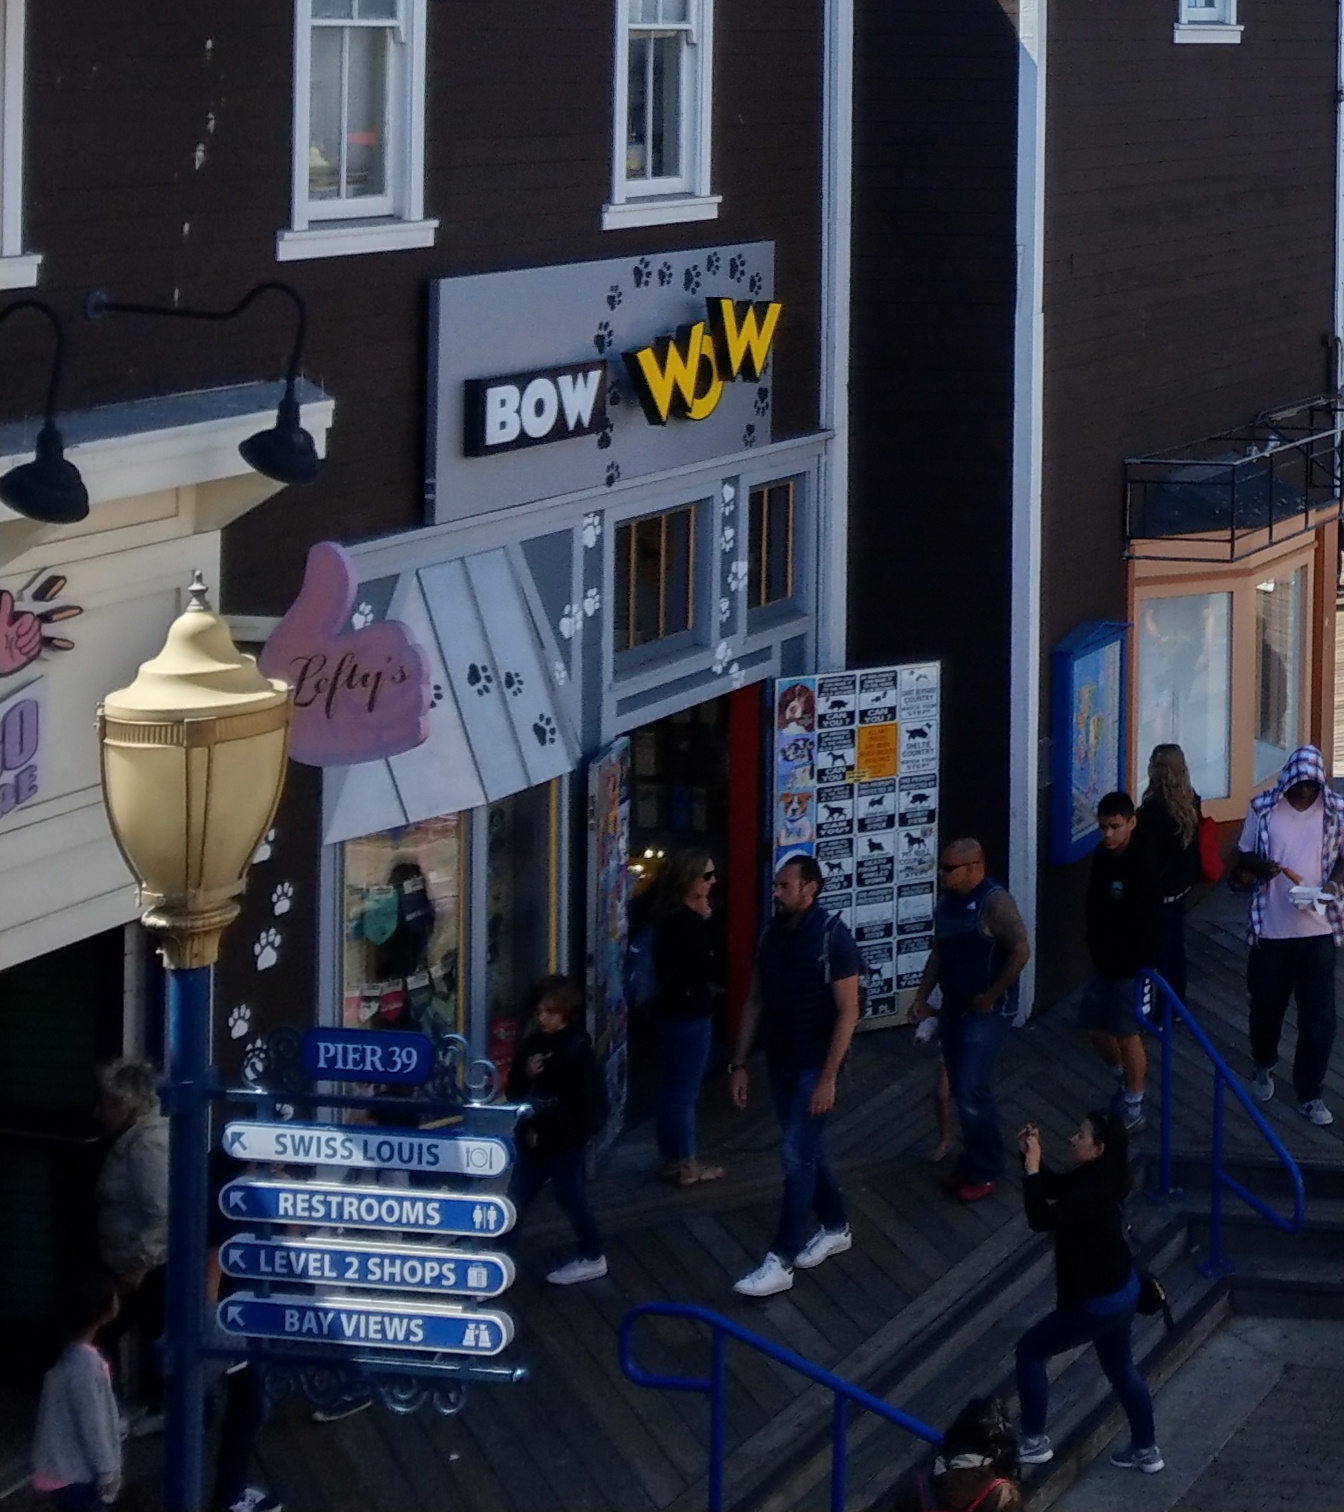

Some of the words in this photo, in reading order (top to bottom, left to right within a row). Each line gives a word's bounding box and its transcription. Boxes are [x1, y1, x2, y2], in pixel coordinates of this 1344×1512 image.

[484, 368, 602, 446] BOW
[634, 297, 783, 423] WOW
[290, 652, 410, 719] Lefty's
[822, 719, 843, 727] YOU
[825, 711, 848, 721] CAN
[863, 715, 883, 723] YOU
[867, 708, 889, 717] CAN
[821, 773, 843, 782] YOU
[825, 766, 847, 775] CAN
[822, 821, 847, 829] CAN
[316, 1041, 386, 1072] PIER
[386, 1045, 418, 1074] 39
[274, 1132, 354, 1161] SWISS
[362, 1138, 440, 1166] LOUIS
[277, 1191, 441, 1226] RESTROOMS
[259, 1248, 337, 1278] LEVEL
[344, 1256, 359, 1280] 2
[366, 1258, 457, 1287] SHOPS
[284, 1308, 335, 1336] BAY
[340, 1312, 424, 1343] VIEWS
